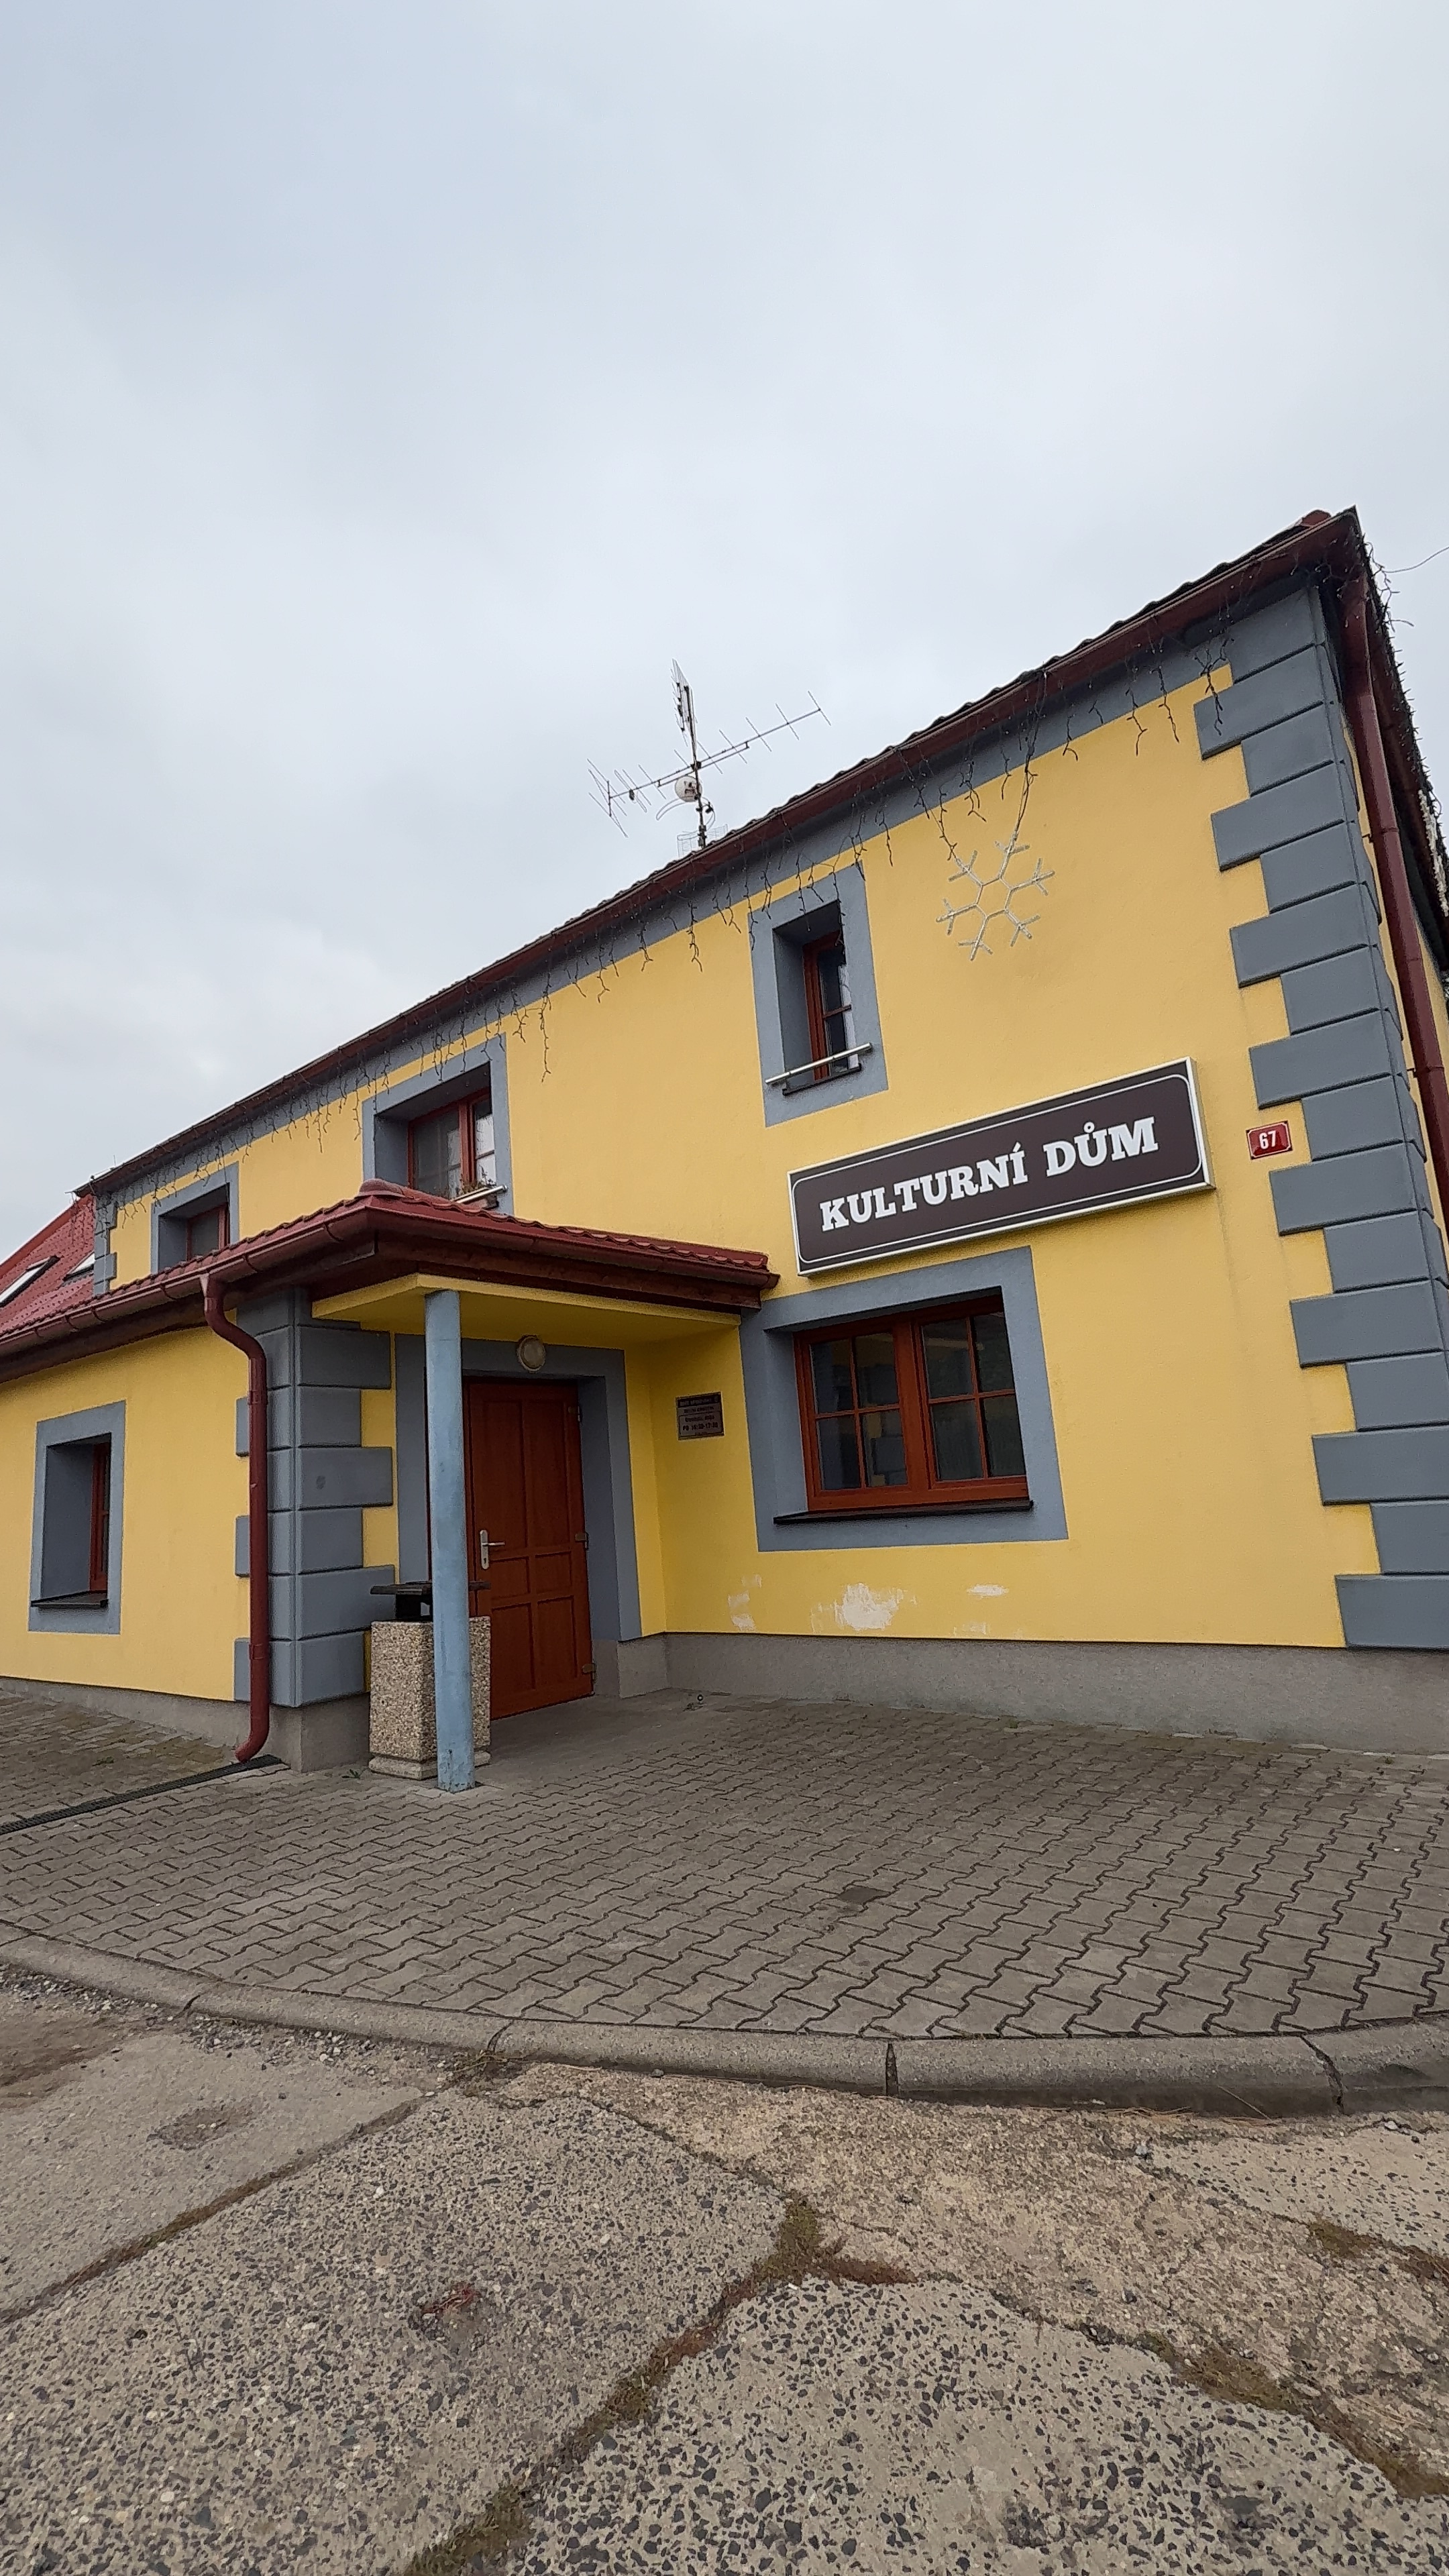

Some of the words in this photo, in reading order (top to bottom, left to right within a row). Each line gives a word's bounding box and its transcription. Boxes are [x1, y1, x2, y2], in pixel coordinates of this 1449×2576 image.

[1259, 1130, 1276, 1149] 67
[819, 1142, 1028, 1232] KULTURNÍ
[1043, 1116, 1159, 1177] DŮM
